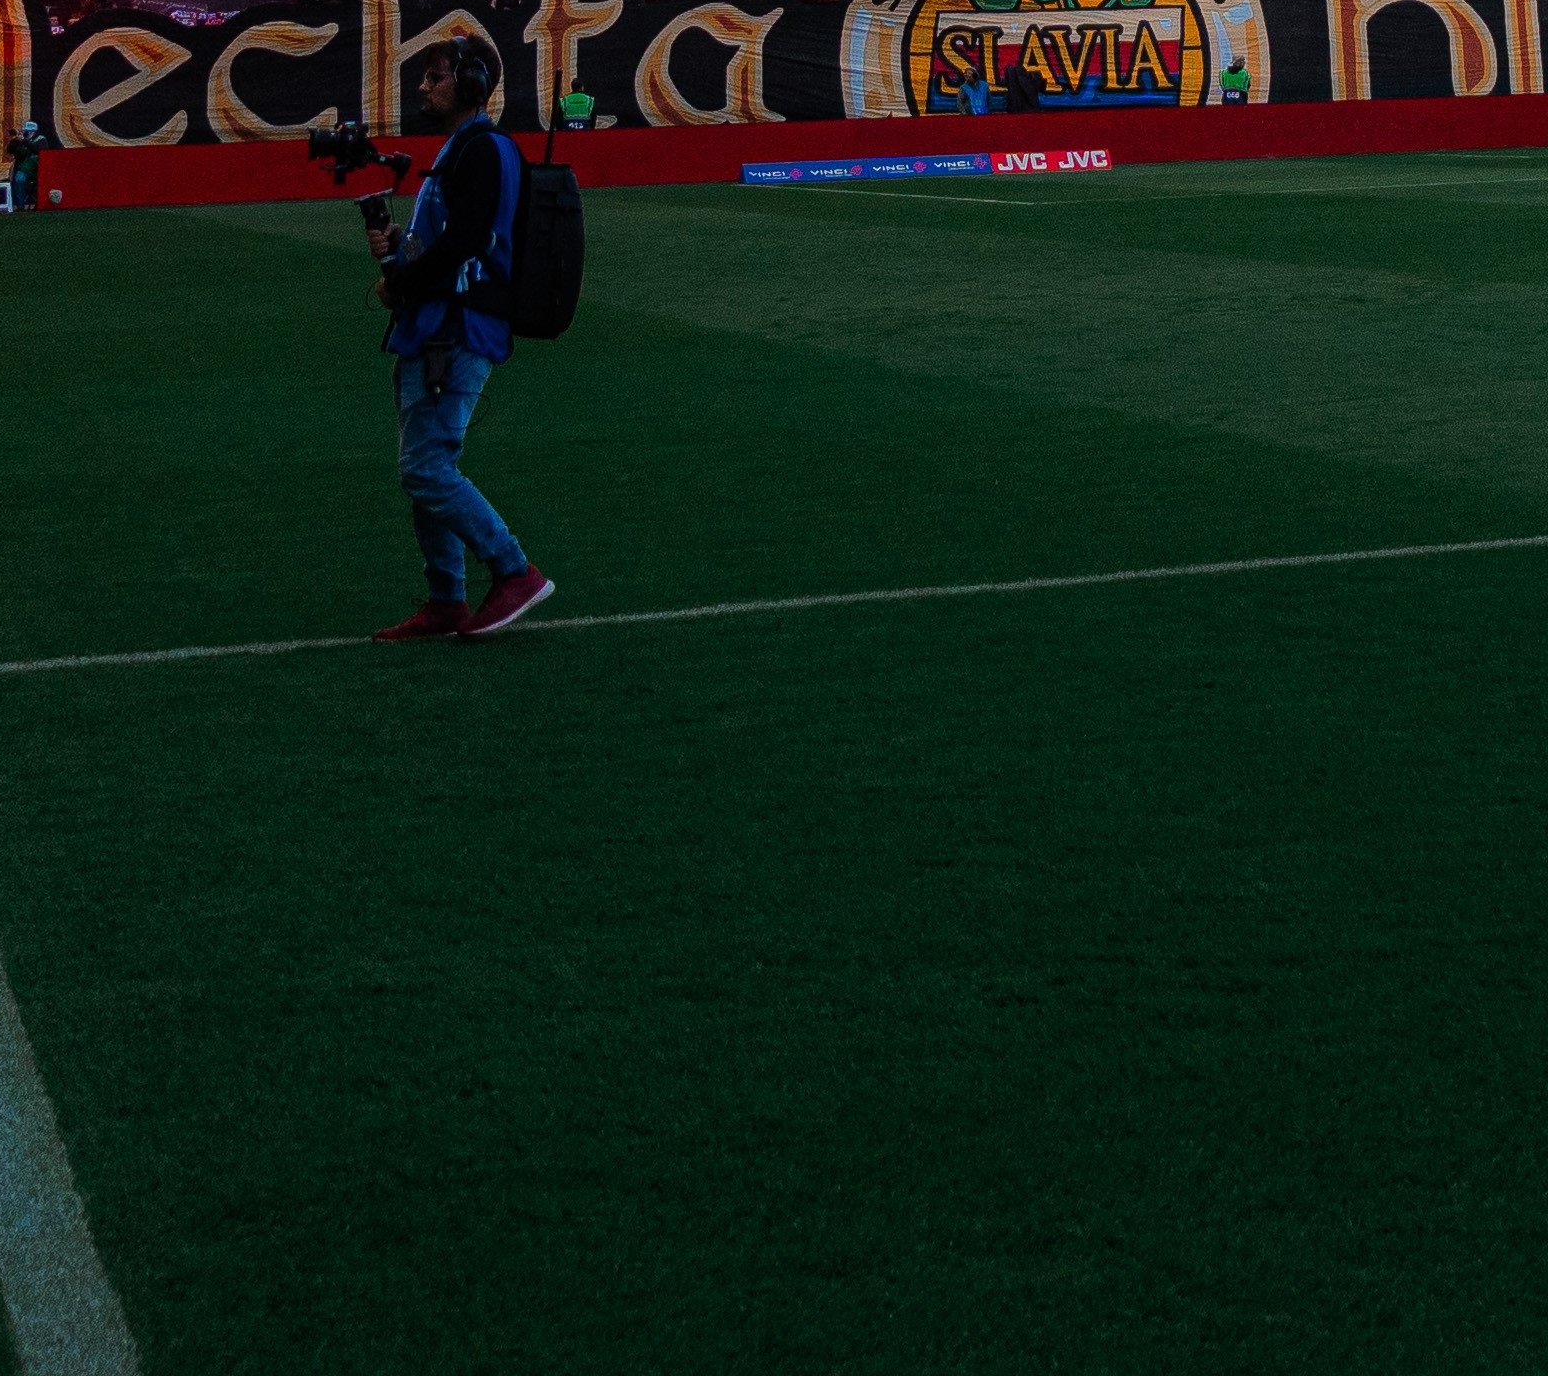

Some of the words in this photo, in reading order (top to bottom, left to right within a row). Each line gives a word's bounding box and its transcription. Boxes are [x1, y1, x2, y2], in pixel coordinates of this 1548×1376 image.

[938, 20, 1175, 95] SLAVIA
[749, 170, 786, 178] VINCI
[810, 168, 848, 176] VINCI
[872, 164, 910, 172] VINCI
[933, 160, 971, 168] VINCI
[998, 152, 1048, 171] JVC
[1058, 150, 1108, 169] JVC
